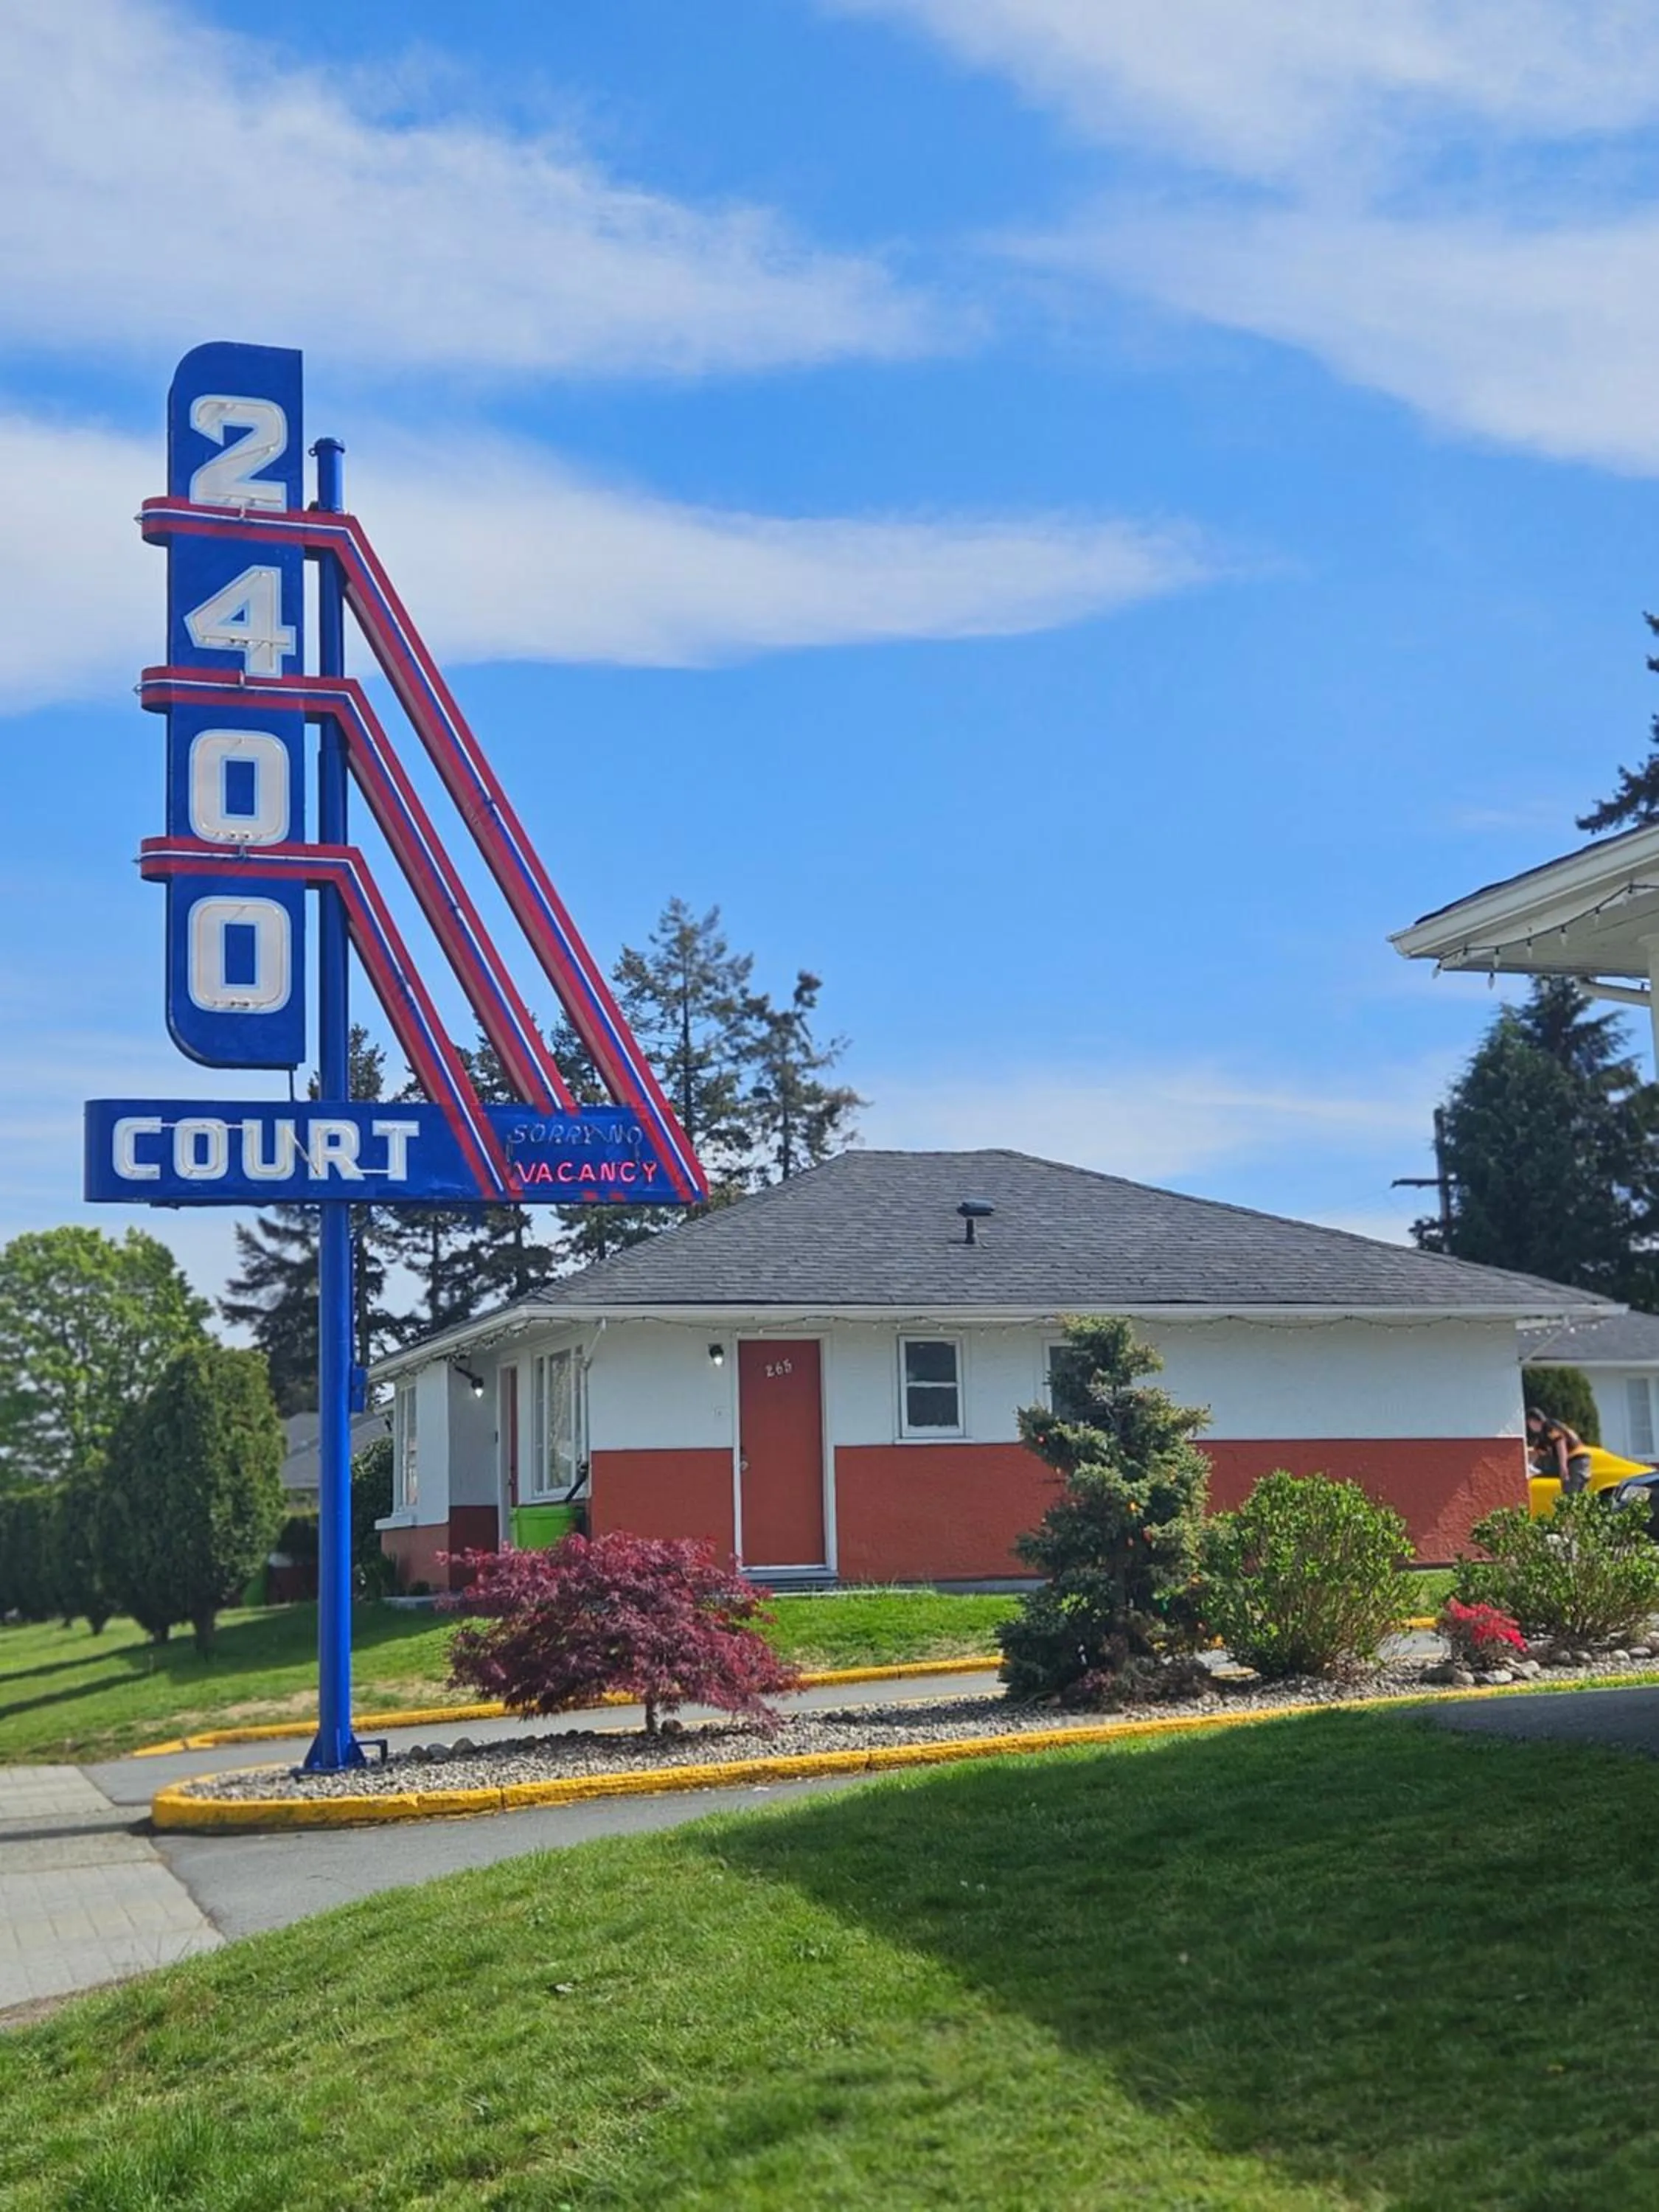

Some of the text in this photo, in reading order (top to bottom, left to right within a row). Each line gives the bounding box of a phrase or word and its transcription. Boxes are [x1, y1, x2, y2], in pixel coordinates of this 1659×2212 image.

[183, 394, 296, 1013] 2400
[113, 1116, 419, 1180] COURT
[509, 1123, 643, 1144] SORRY NO
[516, 1161, 657, 1183] VACANCY
